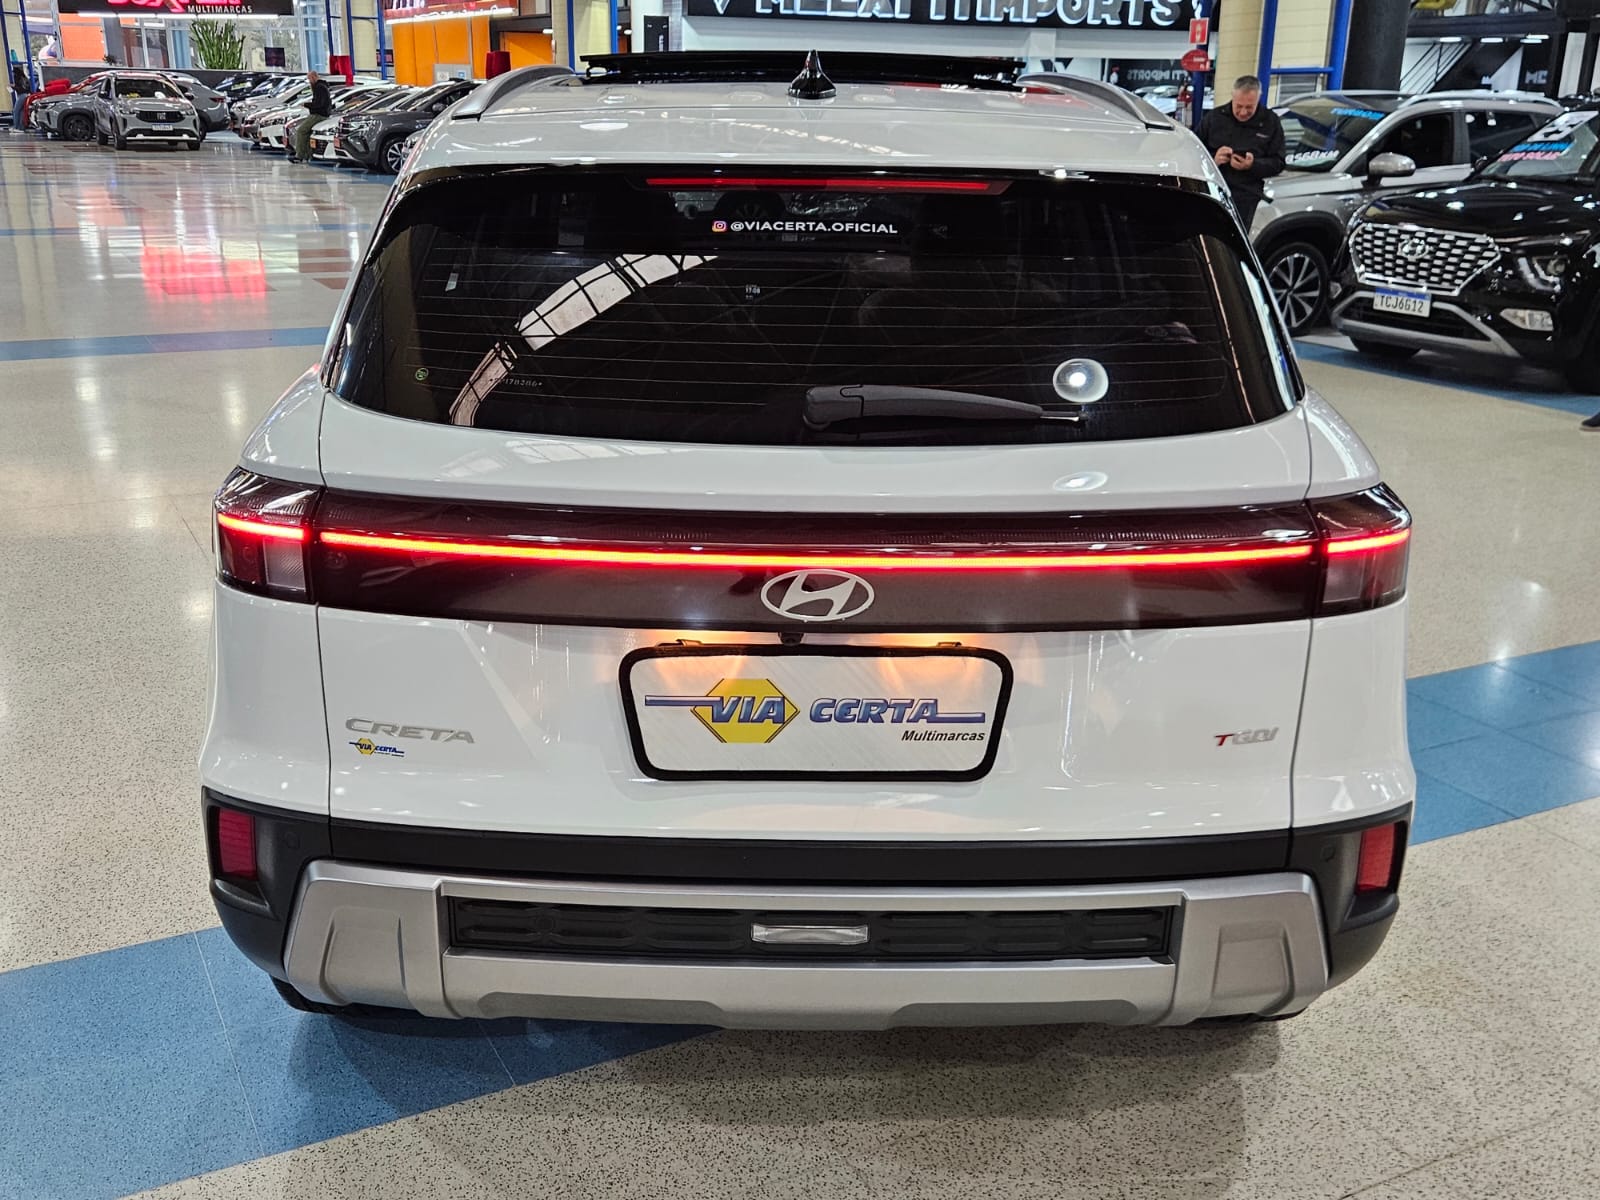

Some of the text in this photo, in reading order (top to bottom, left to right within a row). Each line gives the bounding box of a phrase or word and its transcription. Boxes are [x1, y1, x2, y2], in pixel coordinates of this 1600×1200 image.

[187, 5, 253, 14] MULTIMARCAS
[730, 220, 899, 235] @VIACERTA.OFICIAL
[1379, 295, 1425, 313] TCJ6G12
[711, 695, 938, 724] VIA CERTA
[345, 717, 476, 744] CRETA
[901, 729, 986, 743] Multimarcas
